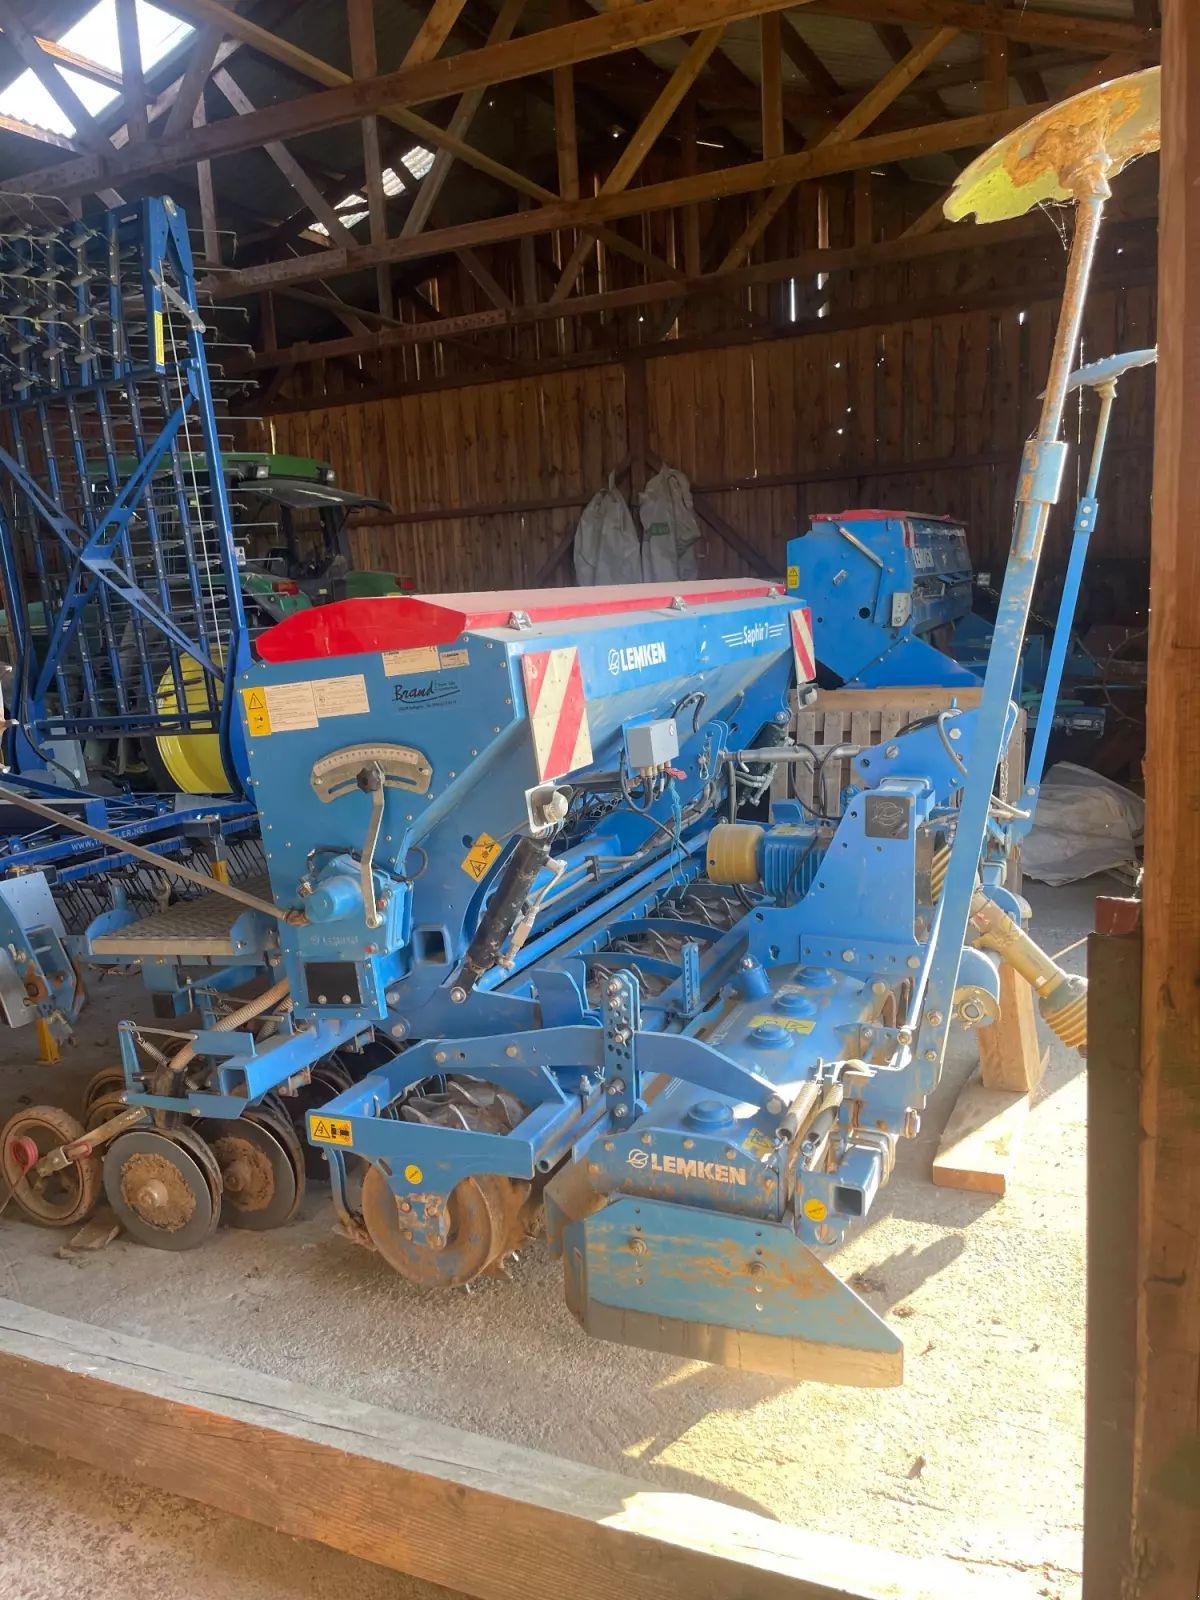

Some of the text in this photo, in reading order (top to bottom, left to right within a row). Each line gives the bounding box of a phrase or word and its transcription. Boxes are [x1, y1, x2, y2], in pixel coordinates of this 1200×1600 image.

[743, 622, 764, 648] Saphir
[619, 642, 666, 672] LEMKEN
[394, 680, 435, 701] Brand
[651, 1153, 746, 1185] LEMKEN
